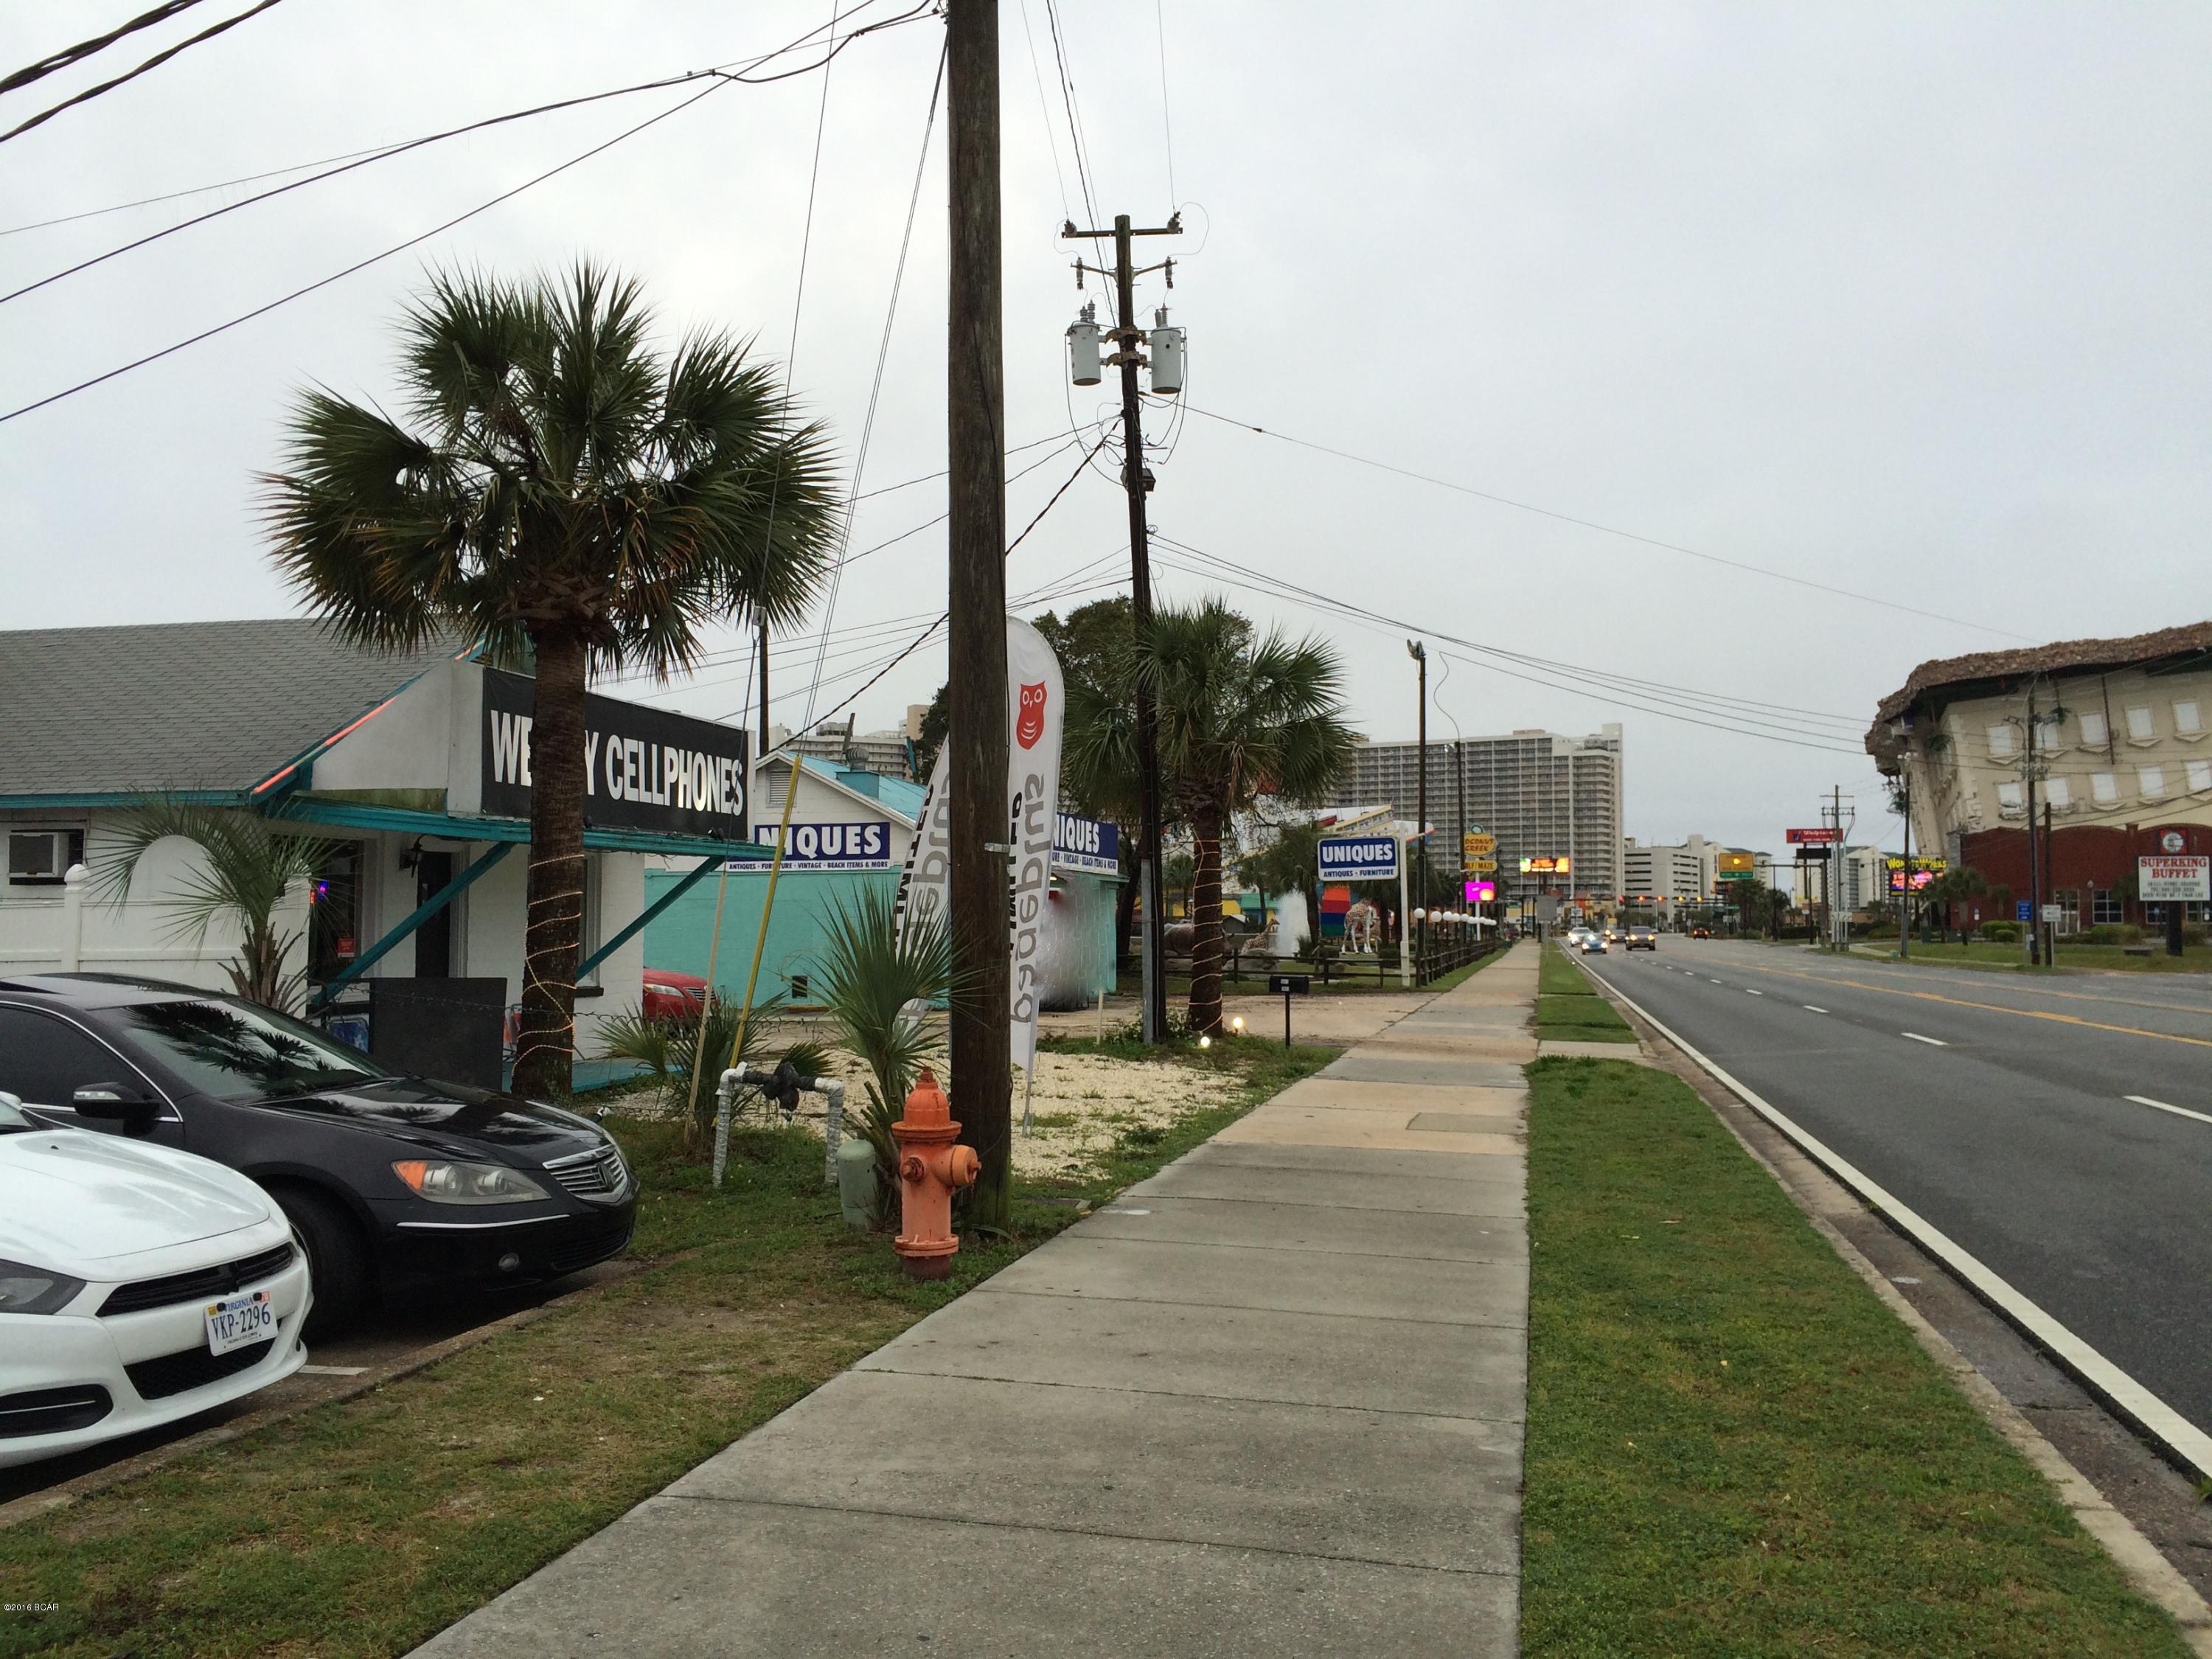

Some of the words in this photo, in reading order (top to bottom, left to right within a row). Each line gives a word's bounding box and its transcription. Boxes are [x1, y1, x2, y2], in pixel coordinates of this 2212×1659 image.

[605, 734, 743, 816] CELLPHONES
[759, 824, 882, 859] NIQUES
[1054, 814, 1099, 854] NIQUES
[728, 862, 757, 870] ANTIQUES
[1322, 844, 1393, 863] UNIQUES
[2140, 857, 2207, 867] SUPERKING
[2152, 869, 2199, 878] BUFFET
[211, 1302, 271, 1340] VKP-2296
